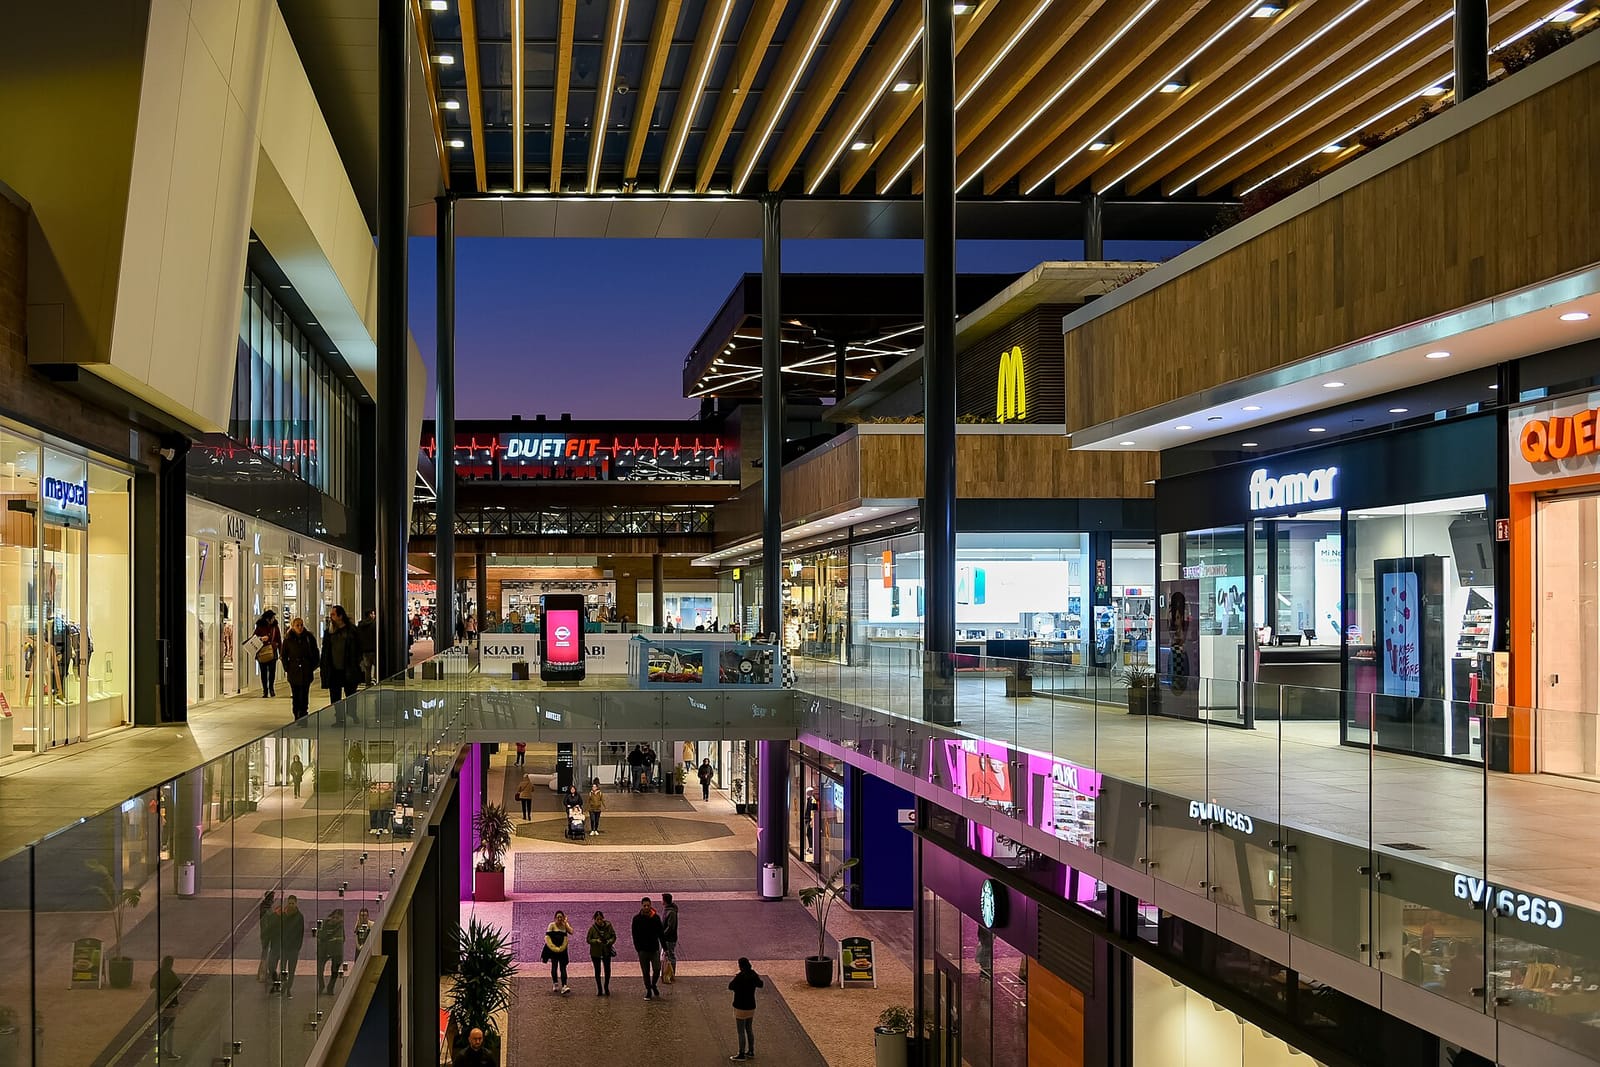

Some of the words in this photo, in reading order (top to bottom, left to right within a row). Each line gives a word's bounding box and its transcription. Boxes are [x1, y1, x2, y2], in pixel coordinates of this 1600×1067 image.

[507, 438, 600, 458] DUETFIT
[1520, 408, 1600, 463] QUE
[45, 477, 88, 509] mayoral
[1249, 466, 1338, 510] flormar
[227, 514, 246, 541] KIABI
[483, 645, 525, 656] KIABI
